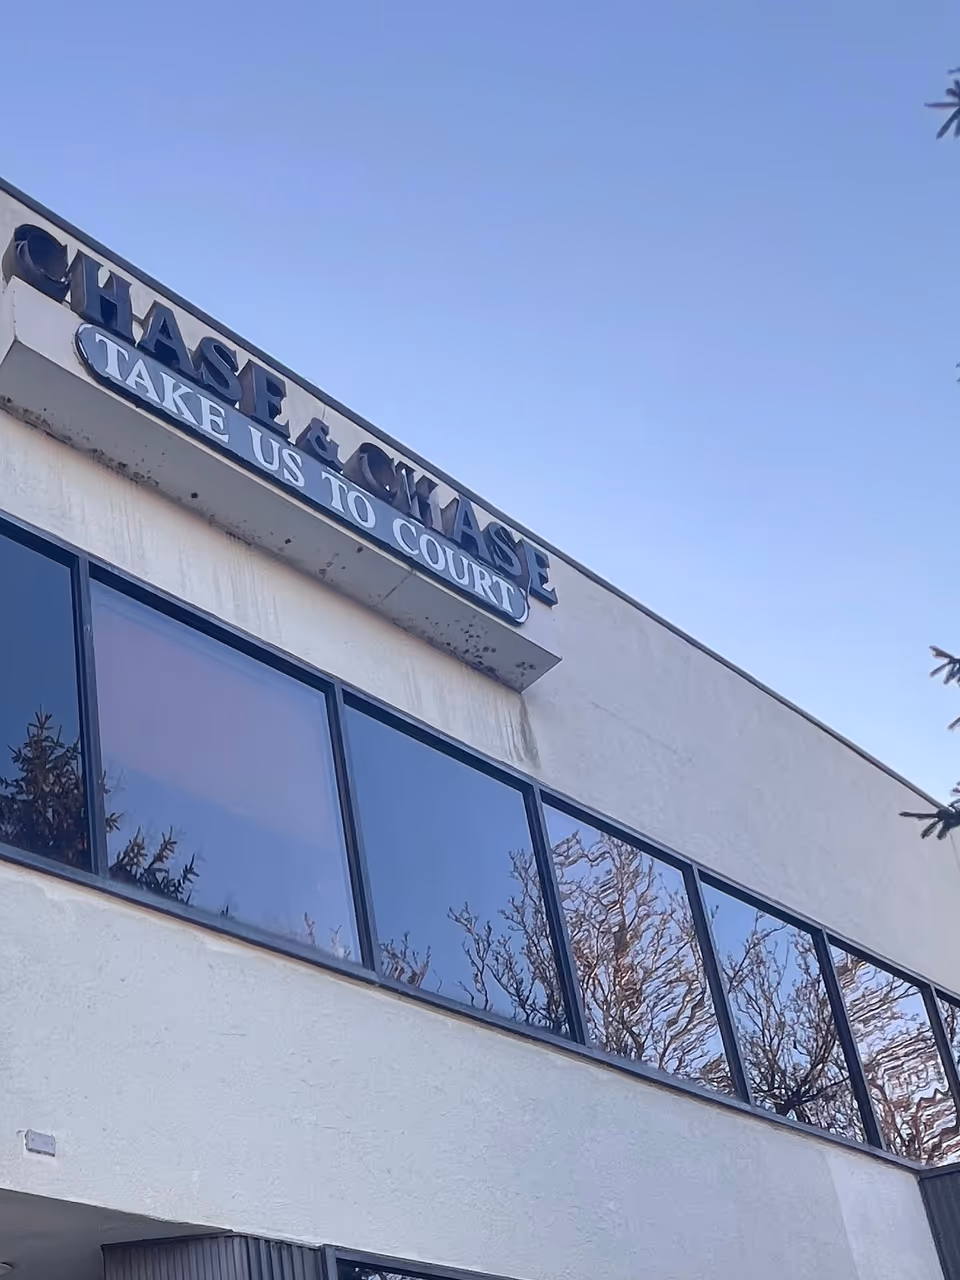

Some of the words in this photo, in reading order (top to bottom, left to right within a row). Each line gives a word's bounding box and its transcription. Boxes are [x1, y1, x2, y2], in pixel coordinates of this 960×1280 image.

[3, 223, 291, 440] CHASE
[296, 417, 344, 471] &
[344, 442, 558, 606] CHASE
[95, 332, 230, 444] TAKE
[249, 425, 306, 488] US
[321, 471, 376, 531] TO
[392, 517, 518, 617] COURT
